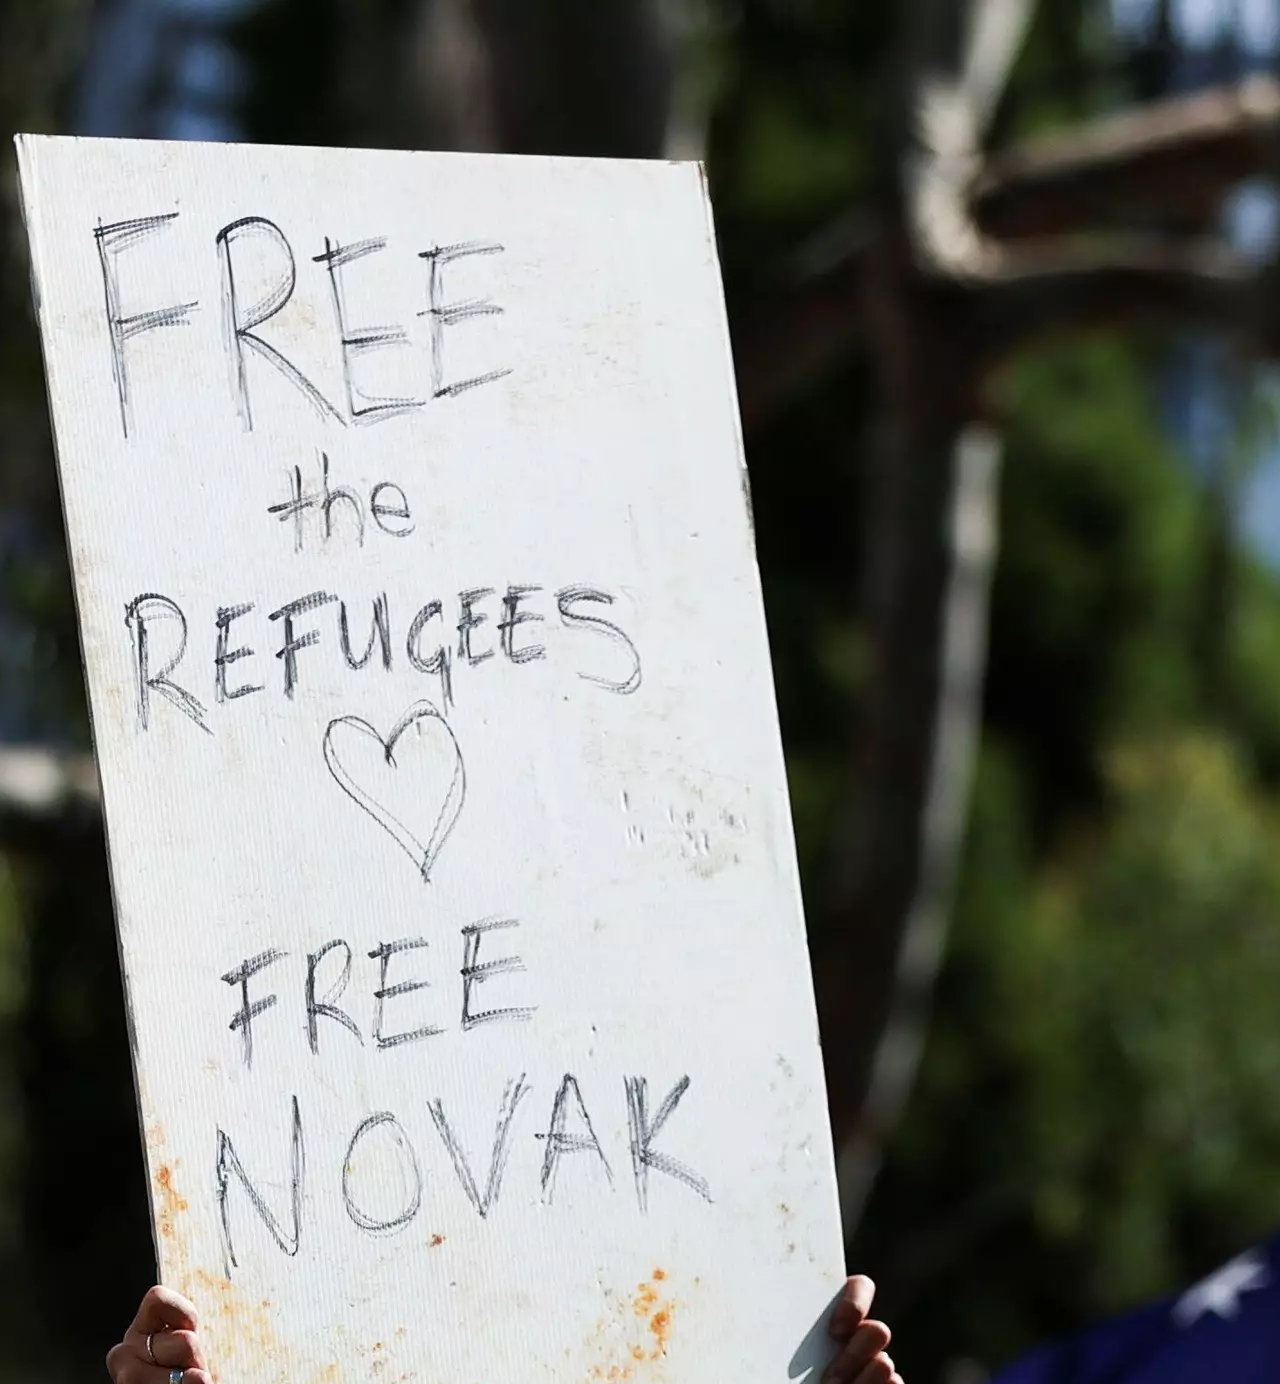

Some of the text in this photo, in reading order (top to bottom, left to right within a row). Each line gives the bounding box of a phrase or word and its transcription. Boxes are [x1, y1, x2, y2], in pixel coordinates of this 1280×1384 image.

[94, 212, 513, 438] FREE
[268, 451, 417, 555] the
[124, 585, 642, 735] REFUGEES
[221, 916, 540, 1069] FREE
[215, 1073, 716, 1280] NOVAK
